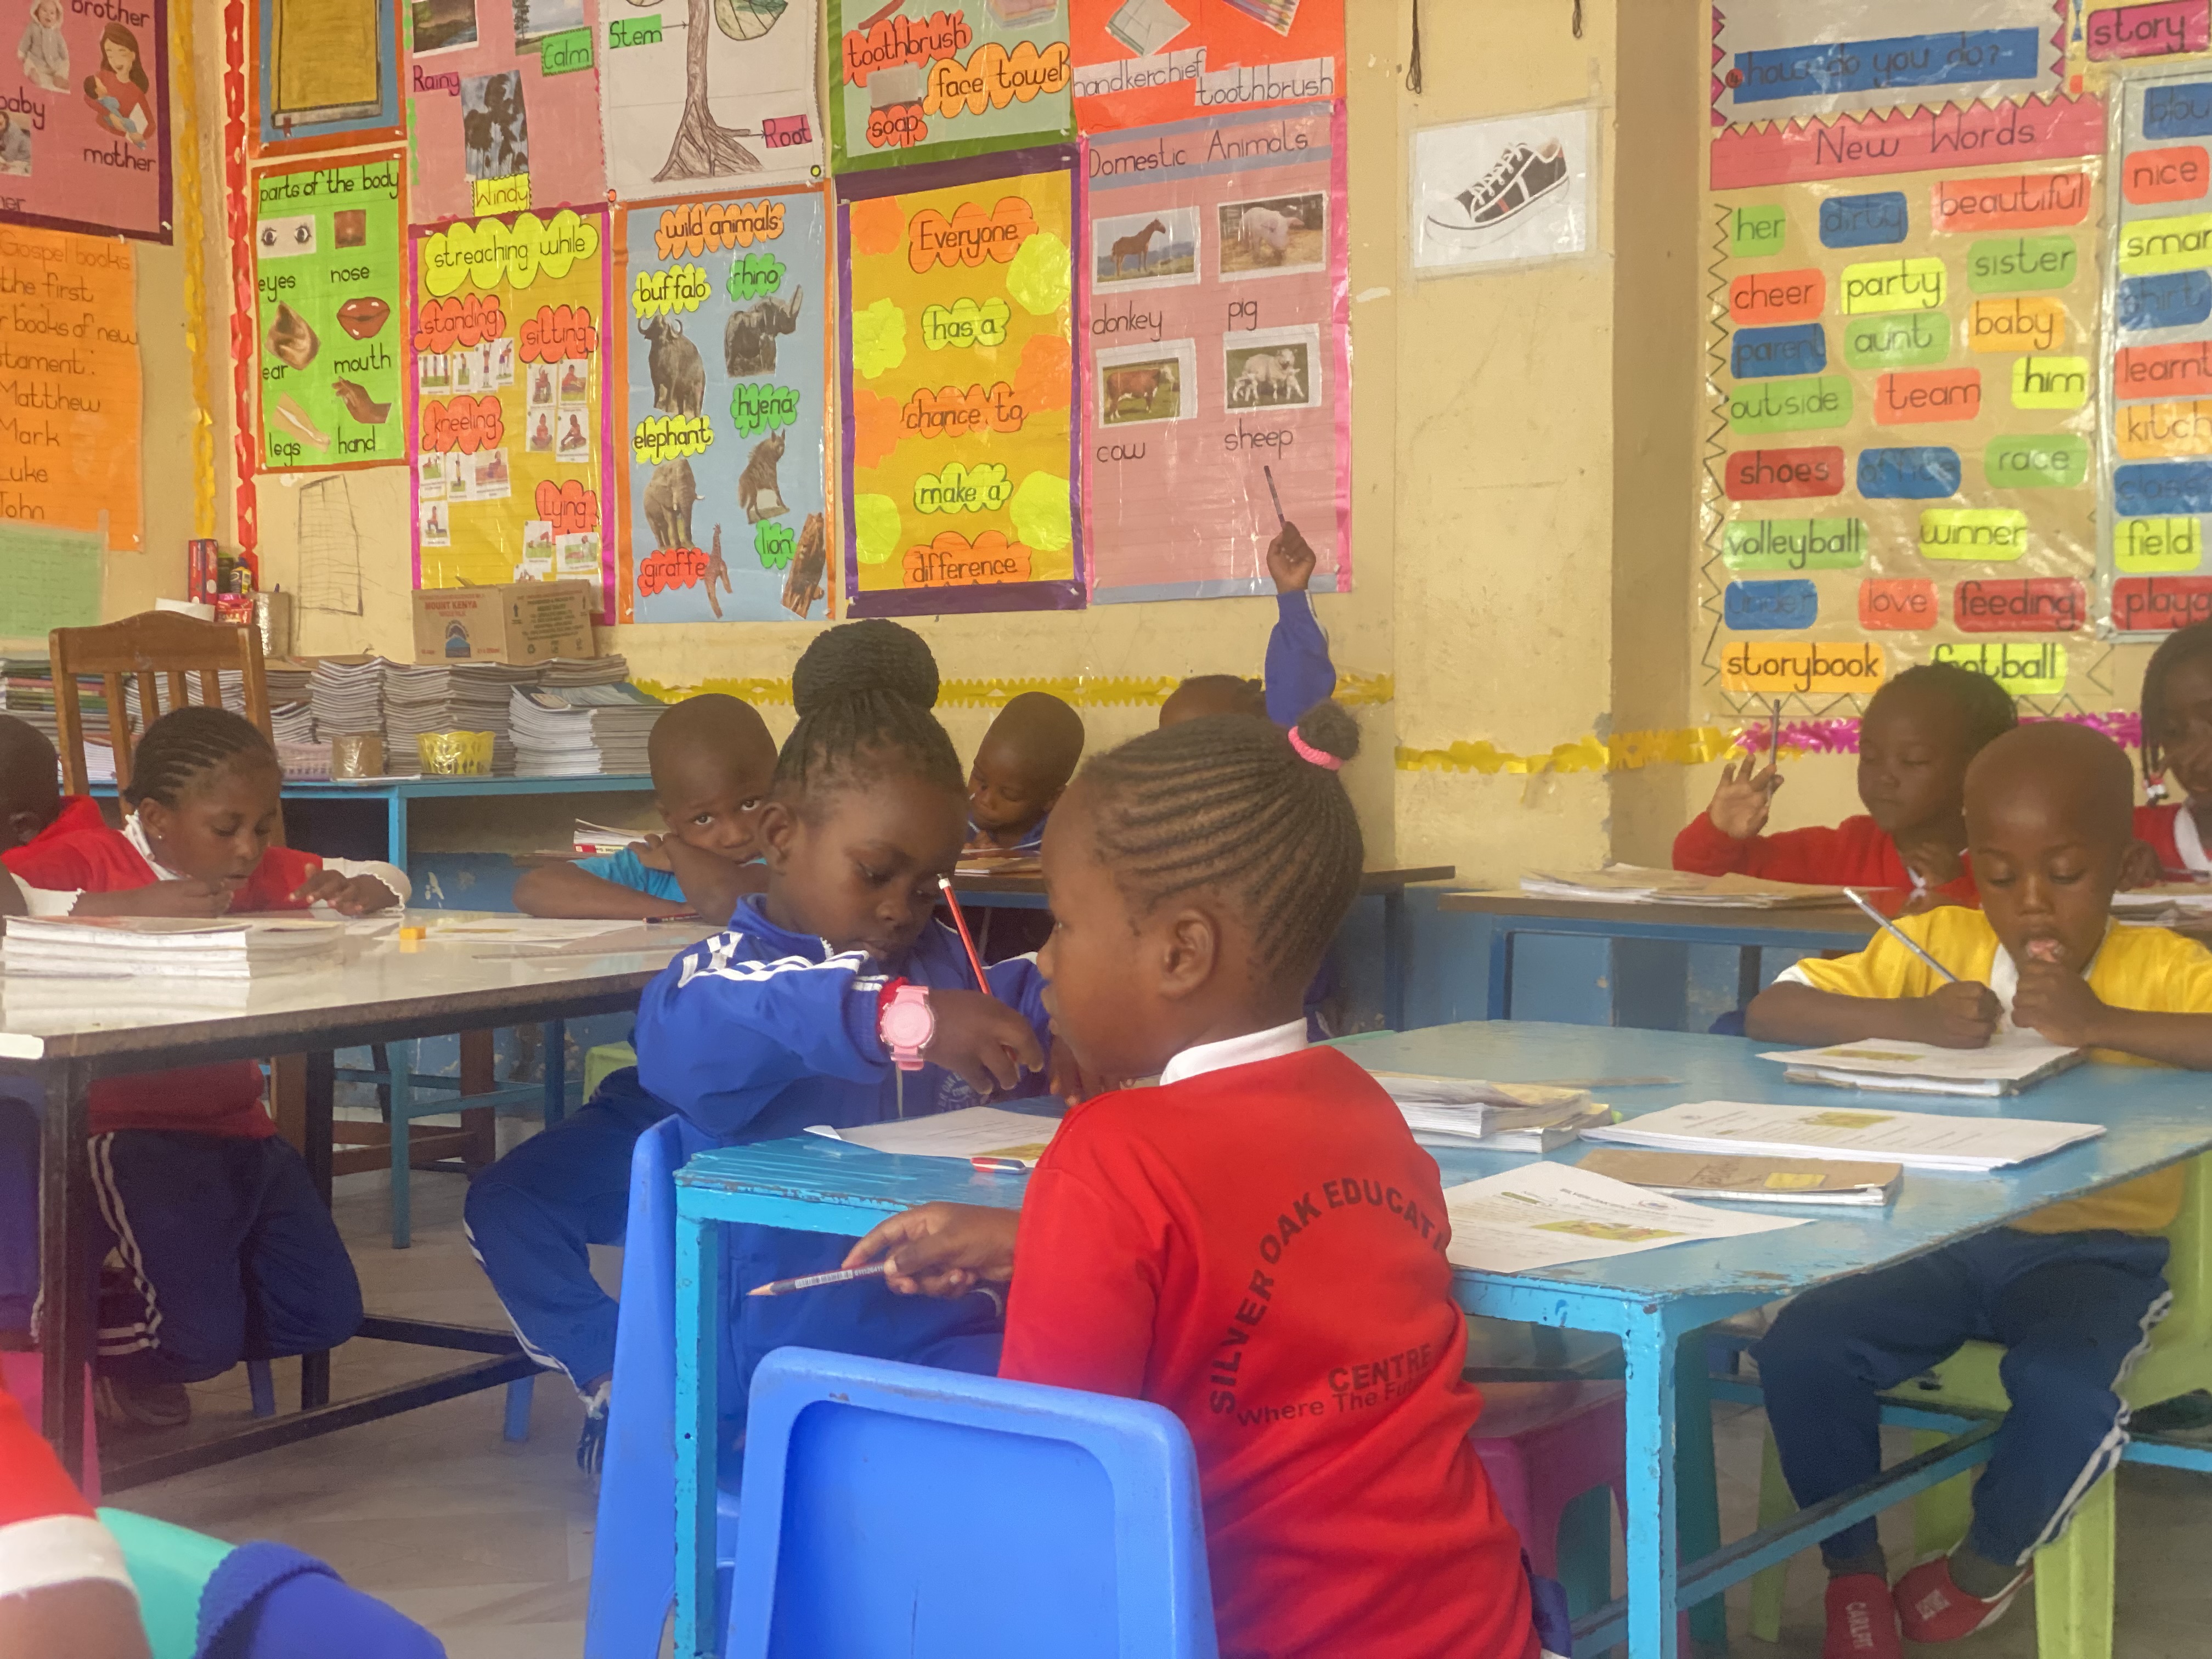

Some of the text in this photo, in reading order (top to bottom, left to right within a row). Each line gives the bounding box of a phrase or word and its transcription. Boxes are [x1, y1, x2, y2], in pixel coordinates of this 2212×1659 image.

[71, 0, 149, 27] brother
[2095, 9, 2185, 52] story
[610, 20, 662, 49] Stem
[850, 17, 966, 67] toothbrush
[544, 40, 589, 70] Calm
[1073, 48, 1206, 98] handkerchief
[1747, 51, 1809, 86] how
[1827, 43, 1860, 76] do
[1873, 45, 1929, 88] you
[1946, 31, 2000, 66] do?
[413, 65, 460, 96] Rainy
[937, 50, 1063, 98] face towel
[1196, 58, 1334, 105] toothbrush
[763, 116, 812, 148] Root
[872, 115, 918, 145] soap
[1816, 109, 2035, 163] New Words
[84, 141, 156, 172] mother
[1089, 121, 1308, 178] Domestic Animals
[259, 162, 398, 213] parts of the body
[2134, 161, 2197, 188] nice
[475, 177, 528, 210] Windy
[1940, 174, 2084, 217] beautiful
[666, 205, 778, 238] wild animals
[921, 221, 1018, 258] Everyone
[1737, 207, 1786, 241] her
[1824, 200, 1903, 242] dirty
[1, 230, 130, 273] Gospel books
[435, 225, 585, 270] streaching while
[1975, 238, 2074, 276] sister
[0, 267, 93, 302] the first
[258, 267, 370, 302] eyes nose
[640, 274, 706, 302] buffalo
[734, 261, 778, 285] rhino
[1735, 274, 1814, 309] cheer
[1847, 259, 1940, 315] party
[14, 304, 139, 345] books of new
[425, 308, 497, 337] standing
[527, 317, 586, 353] sitting
[933, 311, 997, 340] has a
[1093, 298, 1257, 341] donkey pig
[1855, 314, 1932, 352] aunt
[1976, 298, 2053, 350] baby
[263, 342, 391, 379] ear mouth
[1737, 324, 1825, 378] parent
[1886, 374, 1981, 409] team
[2024, 354, 2084, 392] him
[0, 380, 100, 411] Matthew
[738, 388, 793, 428] hyena
[906, 392, 1023, 429] chance to
[1731, 377, 1838, 419] outside
[0, 417, 60, 447] Mark
[434, 404, 495, 440] kneeling
[634, 422, 711, 458] elephant
[1097, 418, 1293, 462] cow sheep
[269, 425, 375, 466] legs hand
[1999, 450, 2069, 471] race
[1740, 450, 1829, 484] shoes
[921, 473, 1000, 504] make a
[543, 488, 586, 528] Lying
[761, 527, 791, 554] lion
[1728, 518, 1859, 569] volleyball
[1921, 524, 2027, 545] winner
[2129, 517, 2193, 556] field
[644, 551, 706, 587] giraffe
[913, 551, 1017, 582] difference
[425, 601, 477, 610] MOUNT KENYA
[1869, 579, 1926, 613] love
[1961, 579, 2074, 630] feeding
[1728, 642, 1878, 693] storybook
[1210, 1269, 1274, 1414] SILVER
[1259, 1193, 1322, 1263] OAK
[1328, 1344, 1431, 1392] CENTRE
[1237, 1400, 1324, 1426] Where
[1332, 1389, 1378, 1412] The
